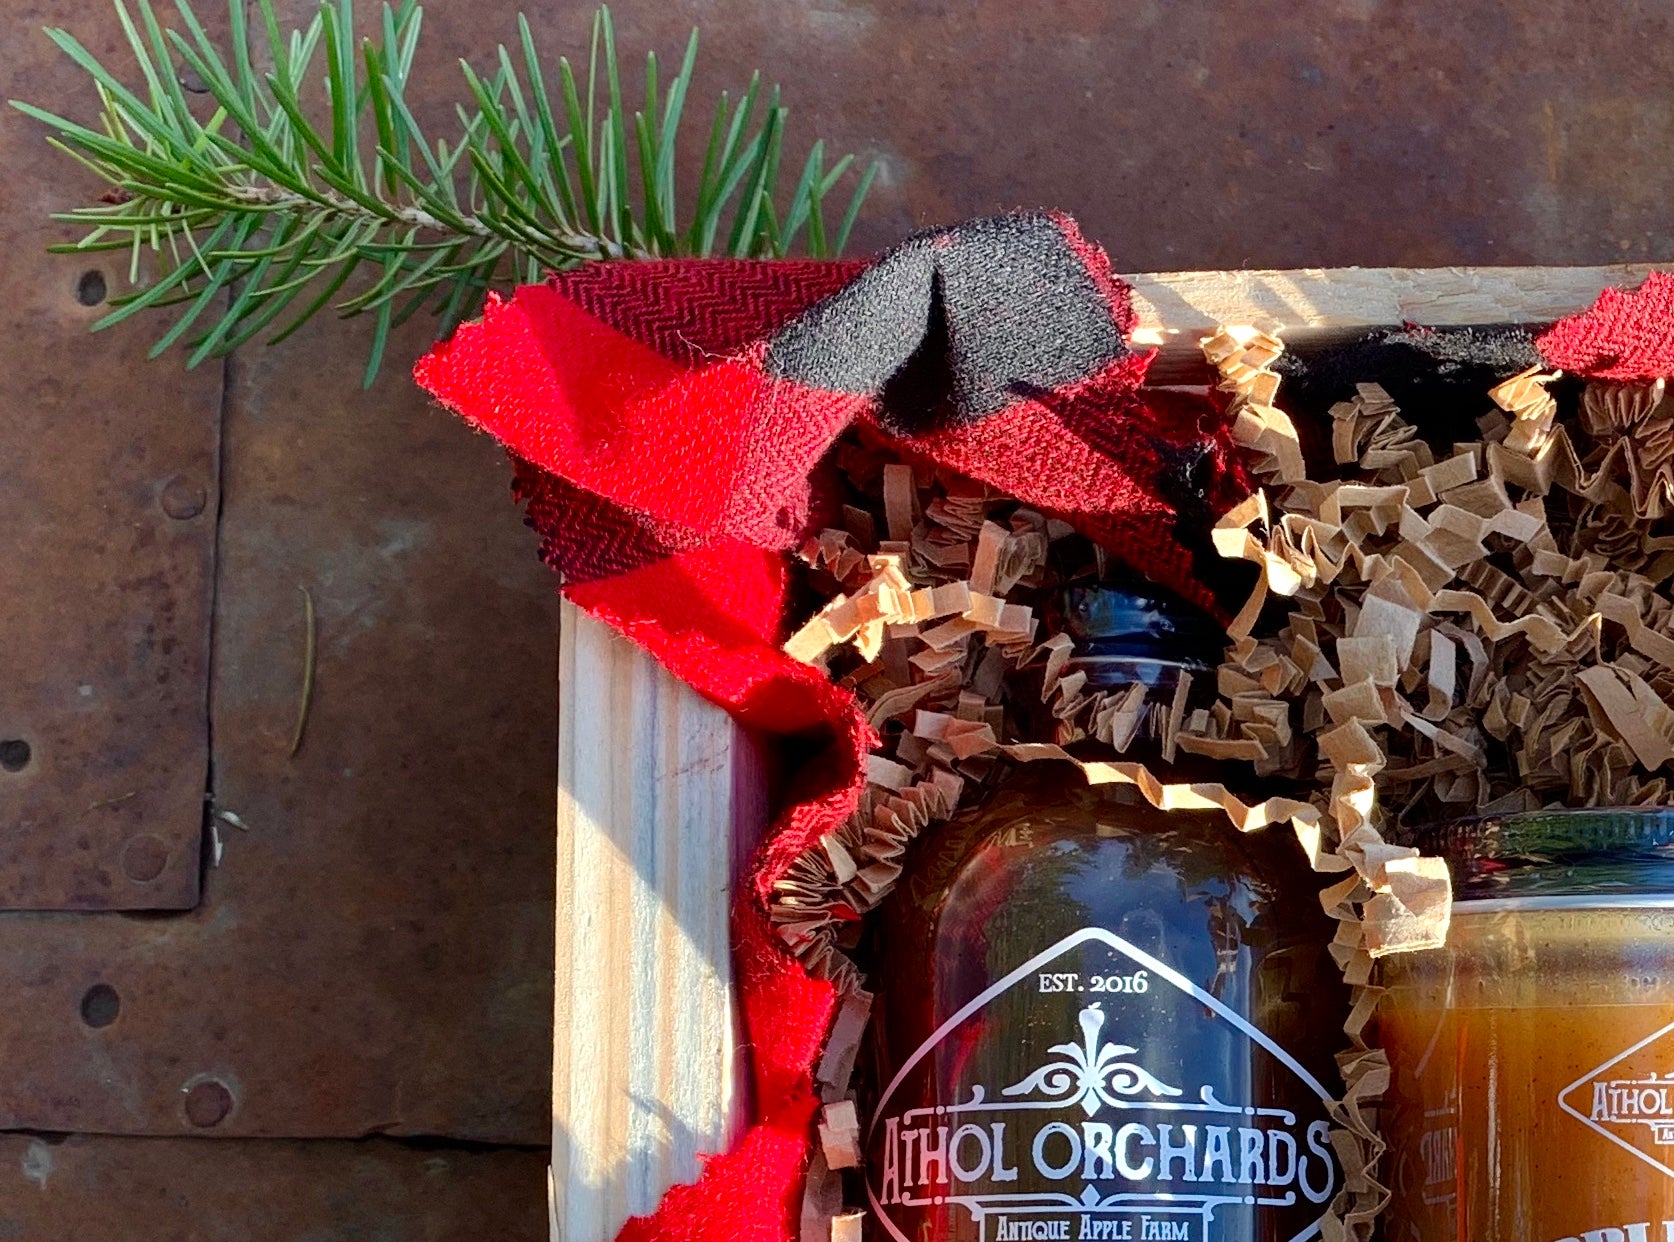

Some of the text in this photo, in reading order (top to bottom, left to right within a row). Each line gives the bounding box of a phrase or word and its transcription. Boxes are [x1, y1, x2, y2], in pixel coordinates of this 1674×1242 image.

[1039, 971, 1149, 994] EST. 2016
[1590, 1082, 1673, 1122] ATHOL
[882, 1116, 1018, 1204] ATHOL
[1032, 1120, 1335, 1204] ORCHARDS
[996, 1214, 1189, 1241] ANTIQUE APPLE FARM
